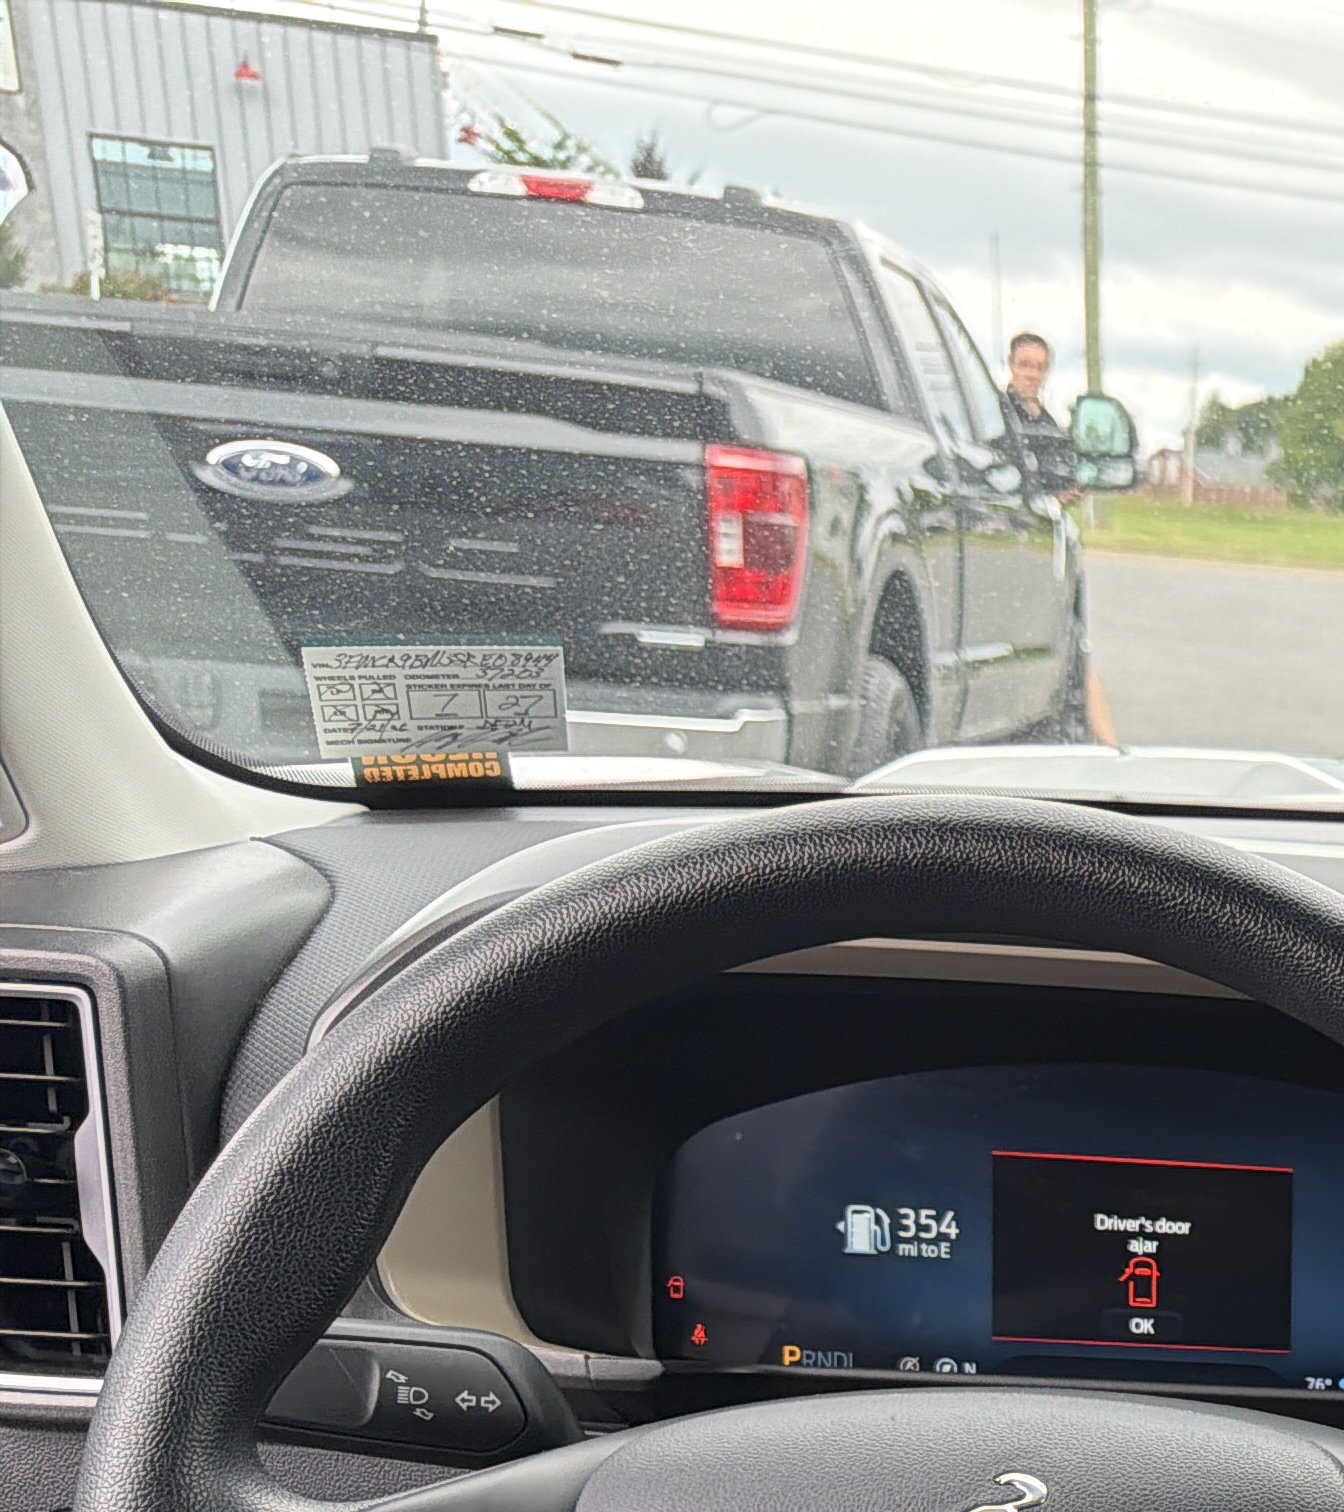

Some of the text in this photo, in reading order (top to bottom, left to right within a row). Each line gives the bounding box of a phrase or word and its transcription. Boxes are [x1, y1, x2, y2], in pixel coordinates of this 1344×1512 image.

[896, 1207, 960, 1240] 354
[1094, 1213, 1192, 1235] Driver's door
[897, 1241, 952, 1259] mi to E
[1127, 1236, 1160, 1255] ajar
[1129, 1317, 1156, 1335] OK
